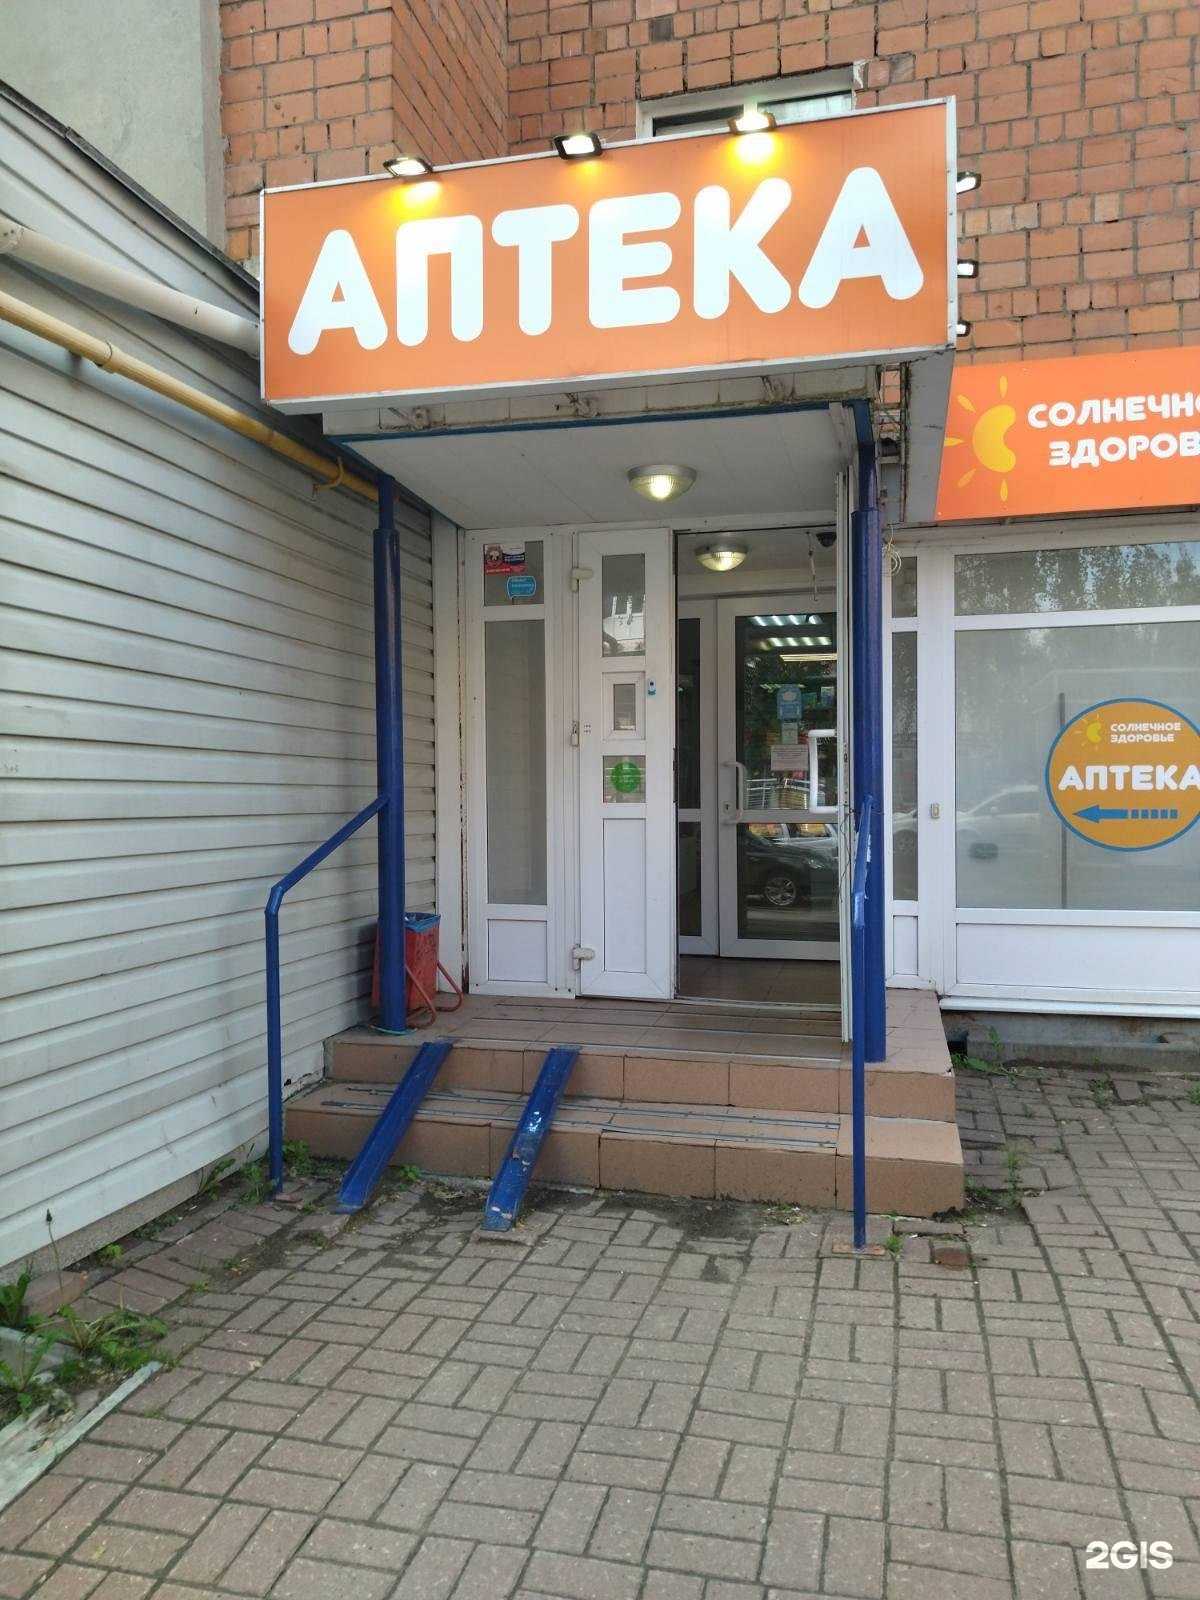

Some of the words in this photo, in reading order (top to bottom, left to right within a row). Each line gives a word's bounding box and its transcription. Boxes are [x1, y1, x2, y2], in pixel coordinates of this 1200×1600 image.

[287, 166, 924, 356] АПТЕКА
[1027, 391, 1200, 429] СОЛНЕЧН
[1048, 431, 1200, 468] ЗДОРОВ
[1110, 722, 1182, 732] СОЛНЕЧНОЕ
[1110, 733, 1175, 744] ЗДОРОВЬЕ
[1058, 765, 1200, 791] АПТЕКА
